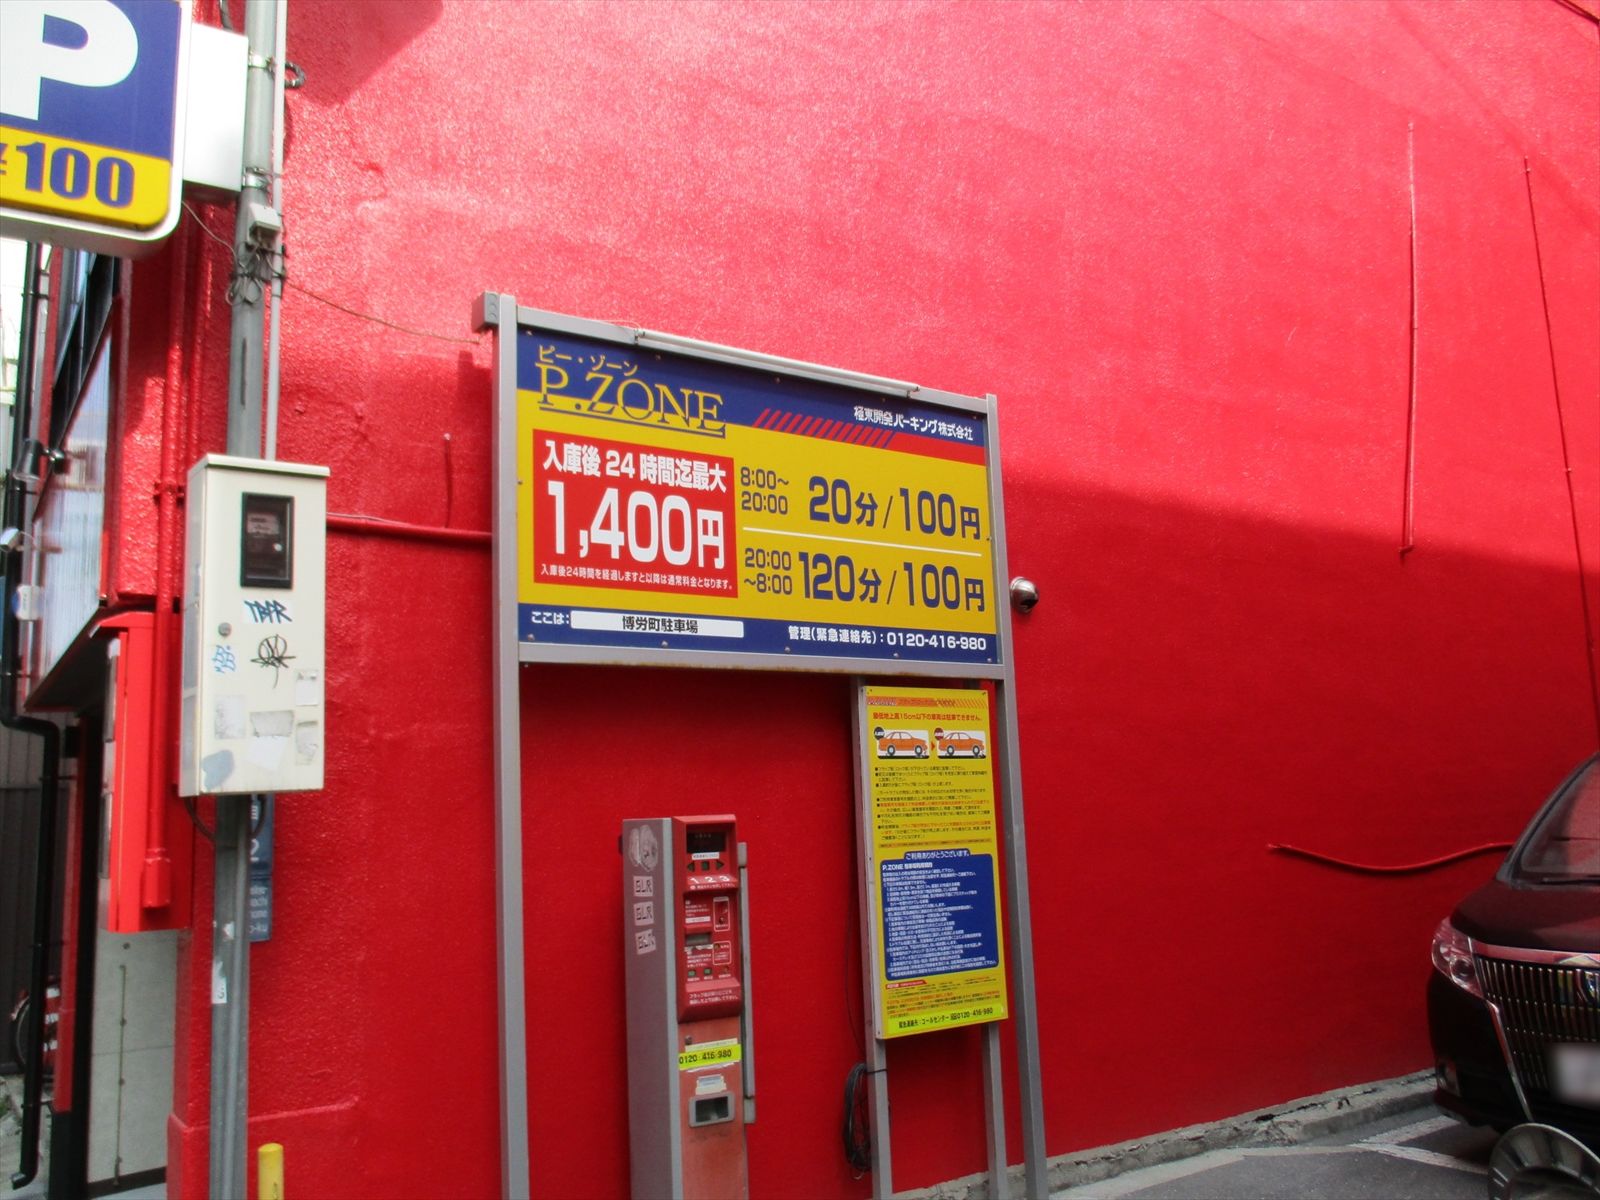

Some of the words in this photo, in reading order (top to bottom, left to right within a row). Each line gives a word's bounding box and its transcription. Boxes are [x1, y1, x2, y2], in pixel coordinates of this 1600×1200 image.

[0, 0, 138, 121] P
[535, 362, 726, 431] P.ZONE
[543, 440, 601, 478] 入庫後
[605, 449, 635, 479] 24
[639, 453, 727, 493] 時間迄最大
[548, 480, 725, 570] 1,400円
[741, 491, 788, 515] 20:00
[744, 548, 792, 571] 20:00
[622, 616, 698, 634] 博労町駐車場
